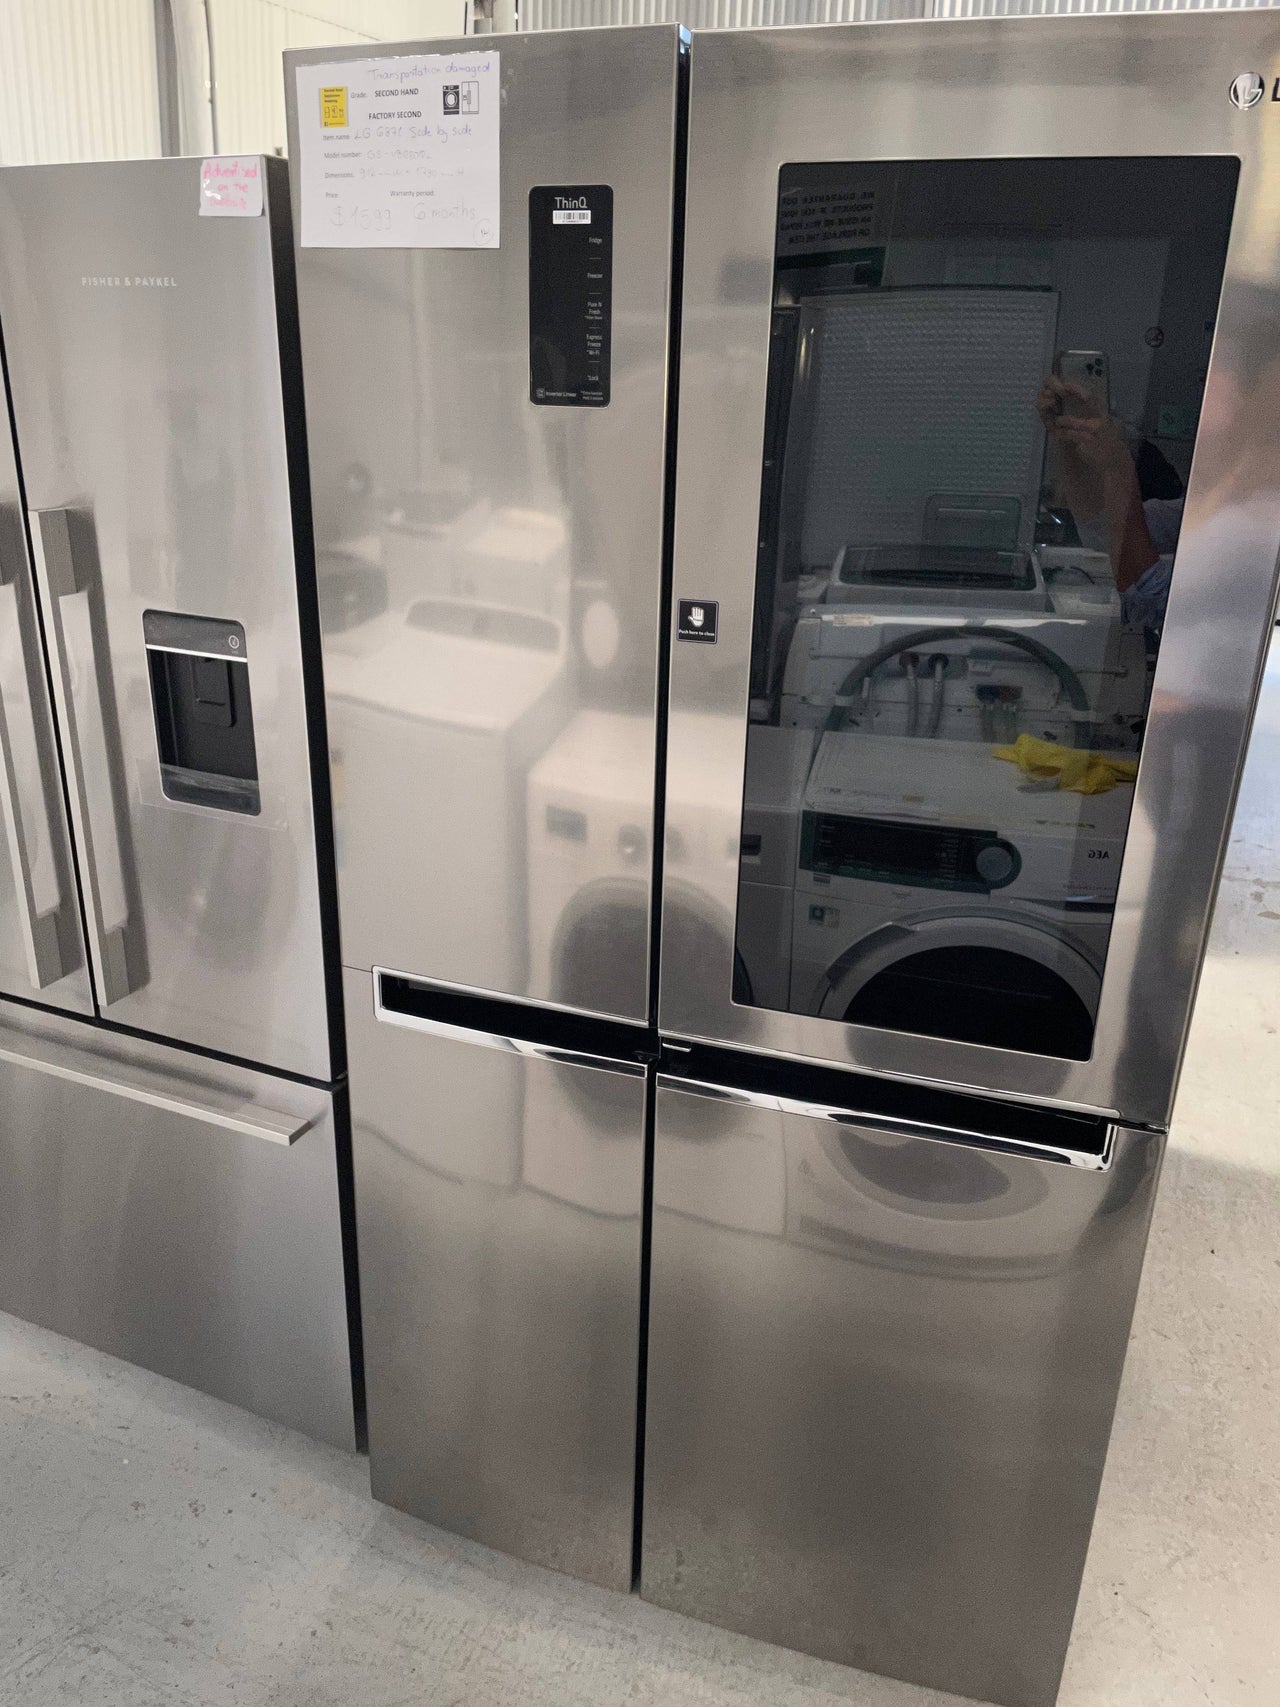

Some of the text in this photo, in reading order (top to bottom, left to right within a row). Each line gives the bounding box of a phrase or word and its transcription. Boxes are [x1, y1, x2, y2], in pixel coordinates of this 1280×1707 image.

[445, 61, 491, 78] damaged
[374, 88, 399, 97] SECOND
[400, 88, 419, 96] HAND
[368, 110, 422, 120] FACTORY SECOND
[436, 124, 448, 143] by
[554, 196, 588, 209] ThinQ
[432, 201, 476, 220] months
[81, 277, 177, 287] FISHER & PAYKEL
